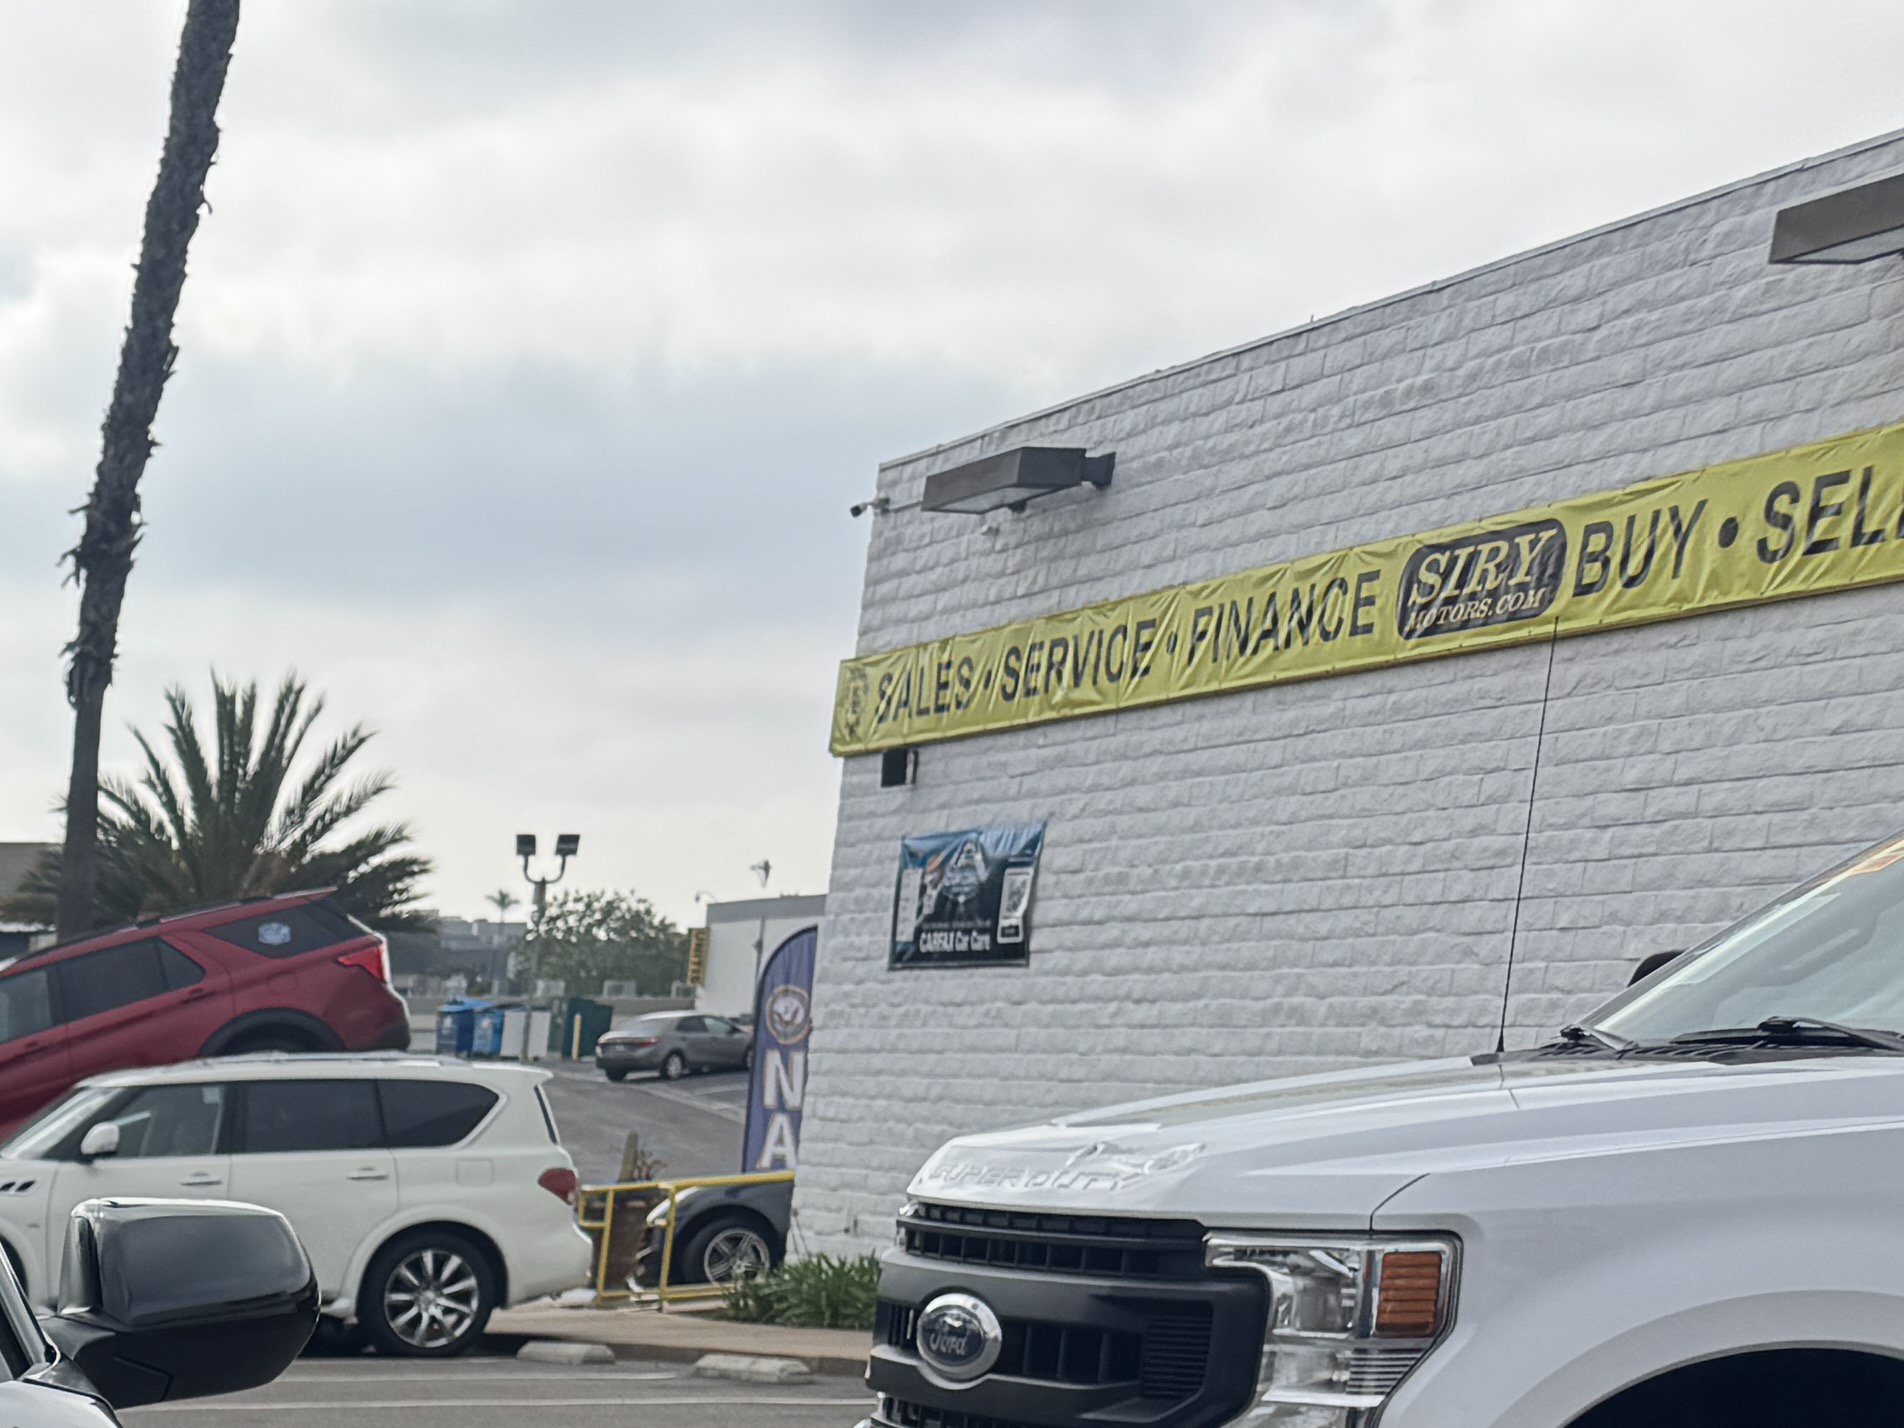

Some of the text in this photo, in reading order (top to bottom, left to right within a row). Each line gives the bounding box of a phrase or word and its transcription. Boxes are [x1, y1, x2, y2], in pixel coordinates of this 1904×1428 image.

[1407, 527, 1559, 606] SIRY
[1573, 466, 1904, 598] BUY SEL
[876, 569, 1382, 724] SALES SERVICE FINANCE
[1406, 587, 1546, 632] MOTORS.COM
